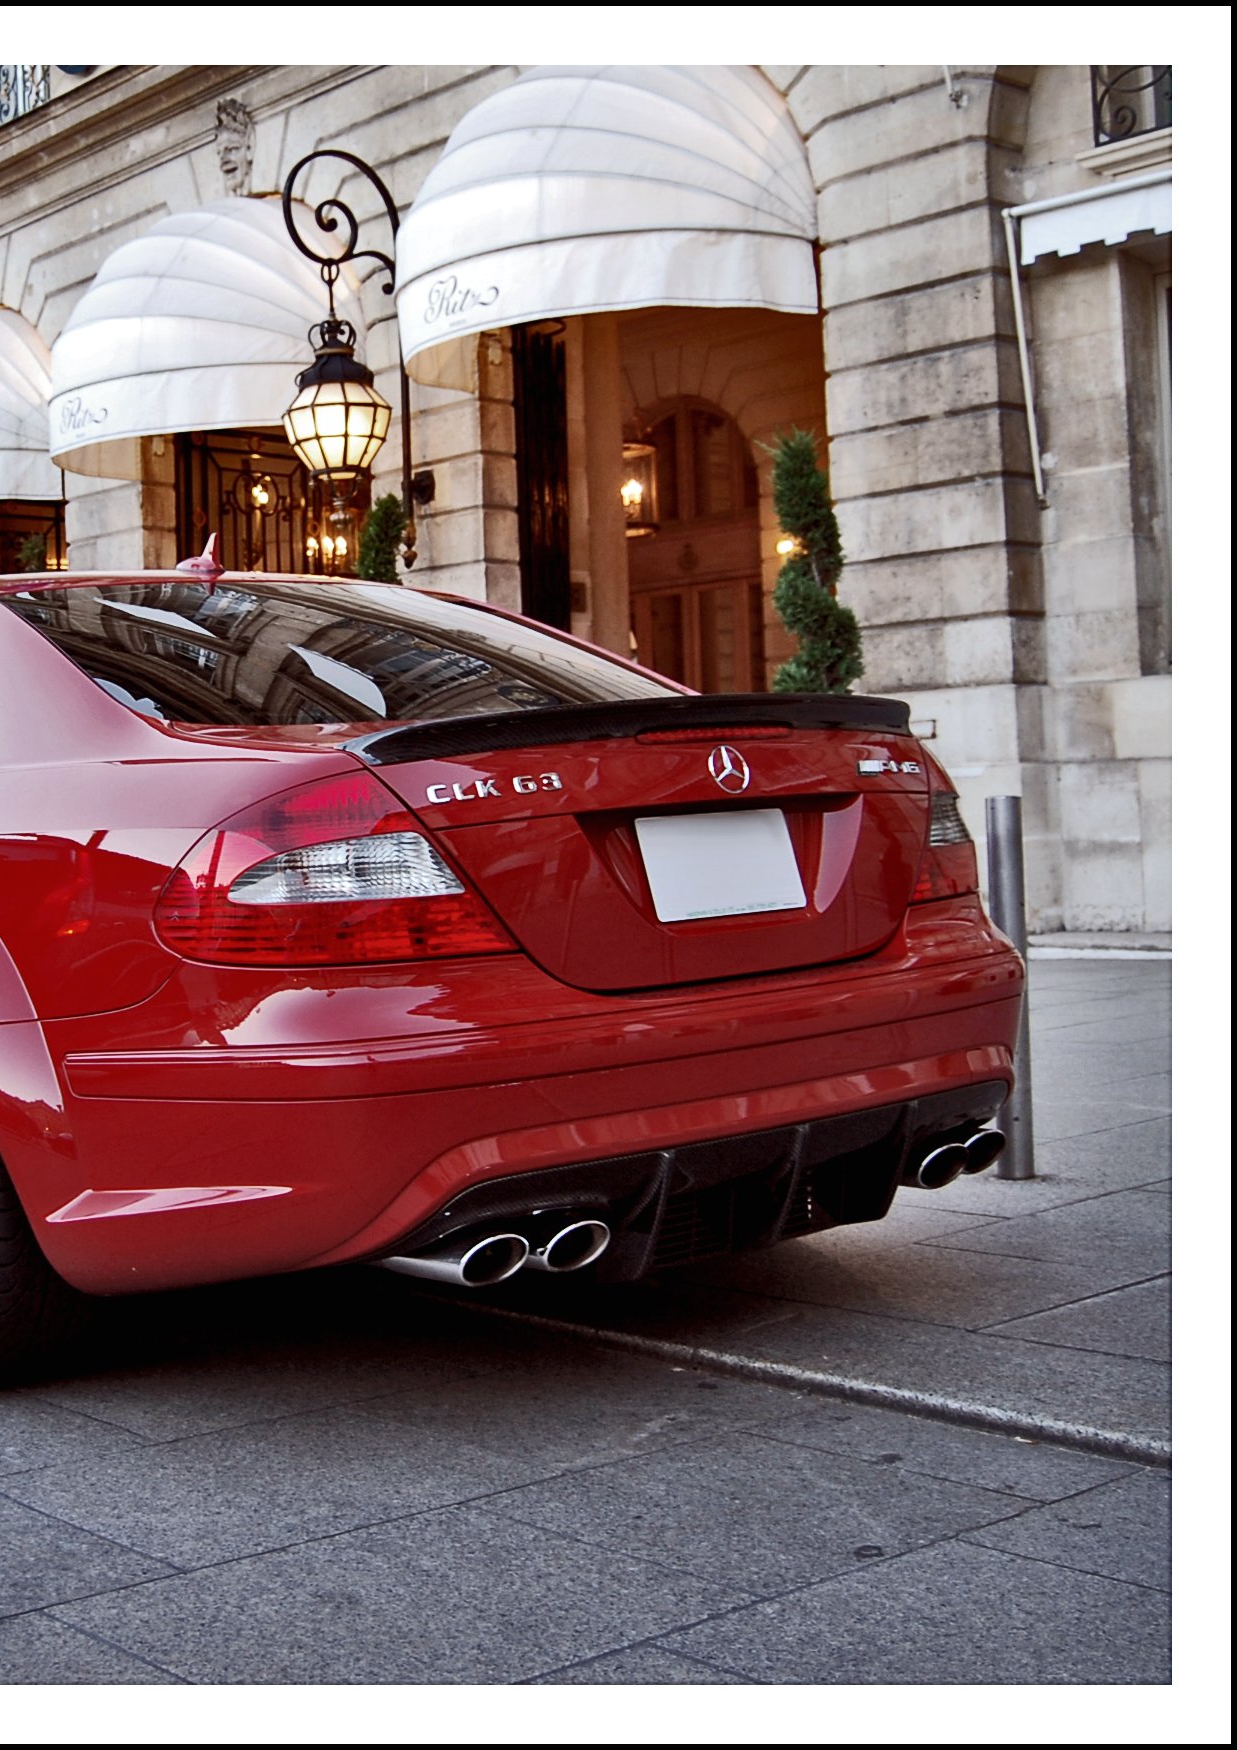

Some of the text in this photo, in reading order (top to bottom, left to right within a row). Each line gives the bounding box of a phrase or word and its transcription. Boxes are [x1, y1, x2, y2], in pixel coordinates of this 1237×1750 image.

[424, 275, 500, 324] Ritz
[60, 397, 109, 434] Ritz
[426, 772, 563, 803] CLK 63
